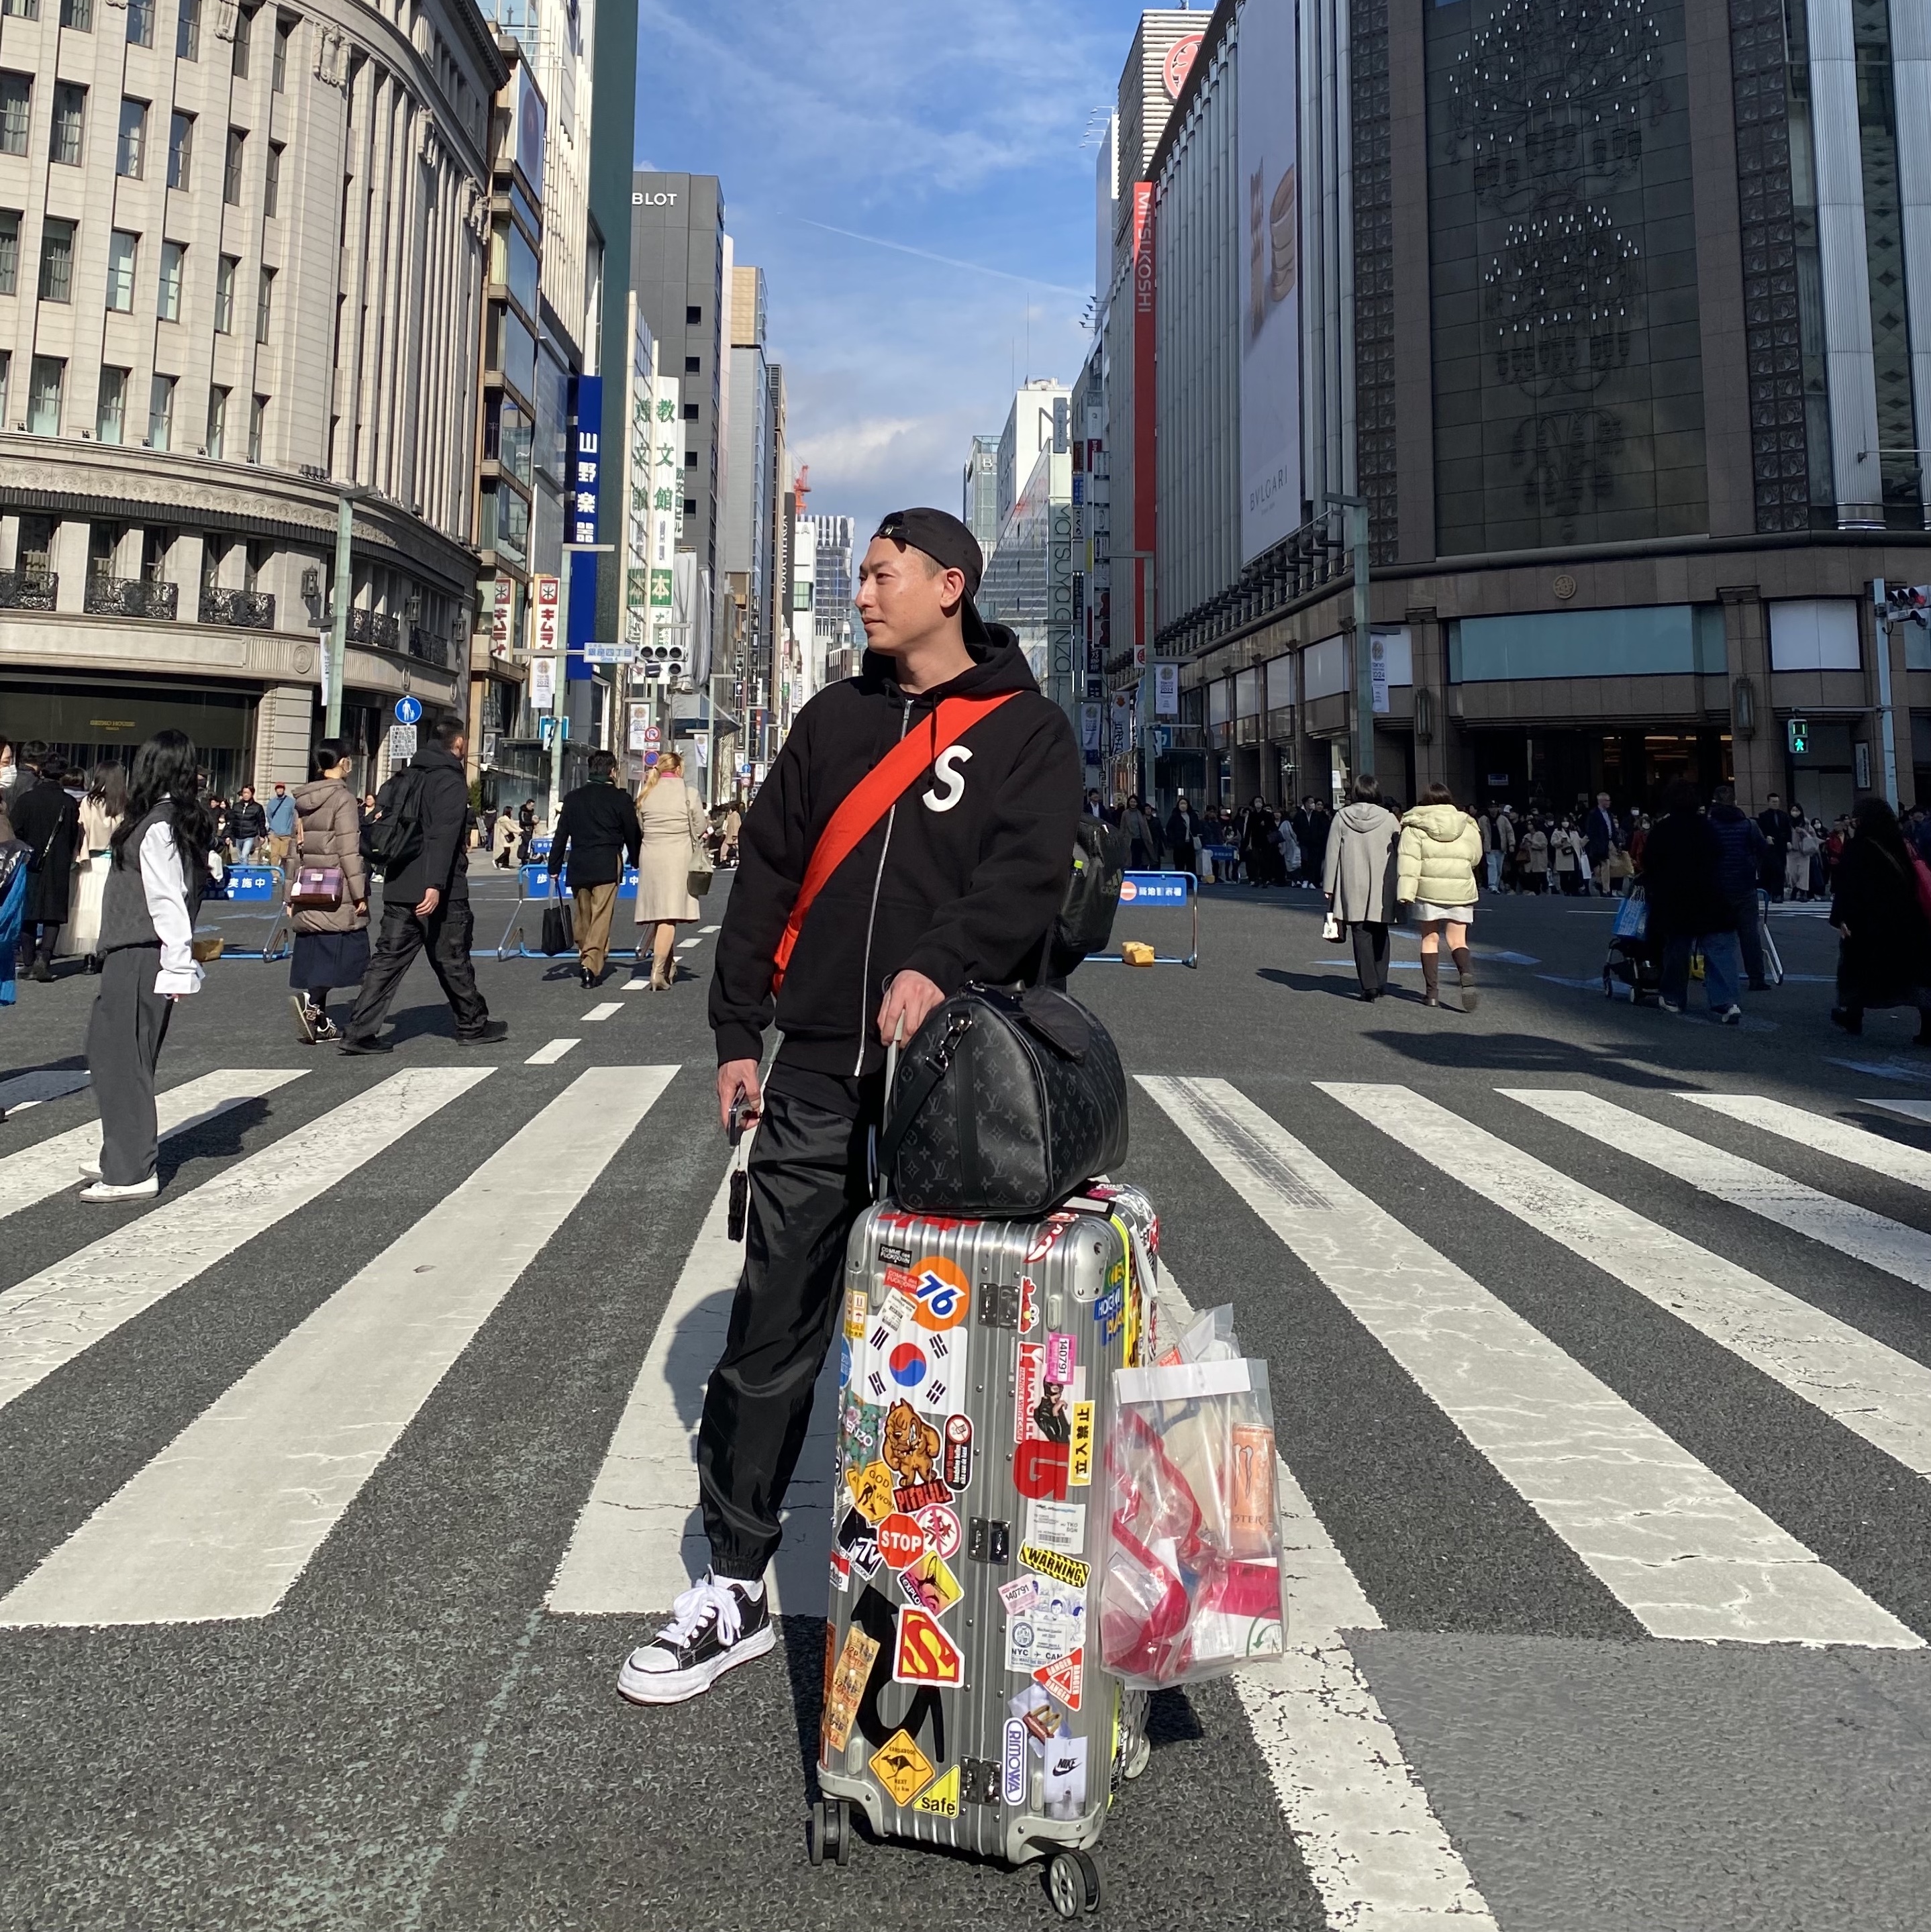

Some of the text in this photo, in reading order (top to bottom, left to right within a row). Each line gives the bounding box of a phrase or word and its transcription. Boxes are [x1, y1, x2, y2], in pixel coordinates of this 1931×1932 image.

[632, 193, 677, 206] BLOT
[1138, 192, 1152, 313] MITSUKOSHI
[654, 399, 676, 512] 教文館
[982, 458, 993, 468] B
[576, 431, 597, 543] 山野楽器
[1250, 464, 1287, 511] BVLGARI
[652, 574, 671, 600] 本
[588, 648, 631, 656] 銀座四丁目
[922, 744, 973, 812] S
[916, 1274, 958, 1315] 76
[1058, 1340, 1068, 1374] 140791
[1075, 1407, 1089, 1474] 立入禁止
[869, 1470, 890, 1488] GOD
[895, 1481, 953, 1513] PITBULL
[881, 1530, 922, 1553] STOP
[1028, 1547, 1081, 1582] WARNING
[1005, 1584, 1030, 1601] 140791
[1011, 1647, 1062, 1660] NYC CAN
[1046, 1657, 1073, 1676] DANGER
[1045, 1678, 1071, 1702] DANGER
[1072, 1664, 1081, 1695] DANGER
[1008, 1730, 1022, 1793] RIMOWA
[1057, 1758, 1078, 1770] NIKE
[922, 1796, 955, 1815] safe
